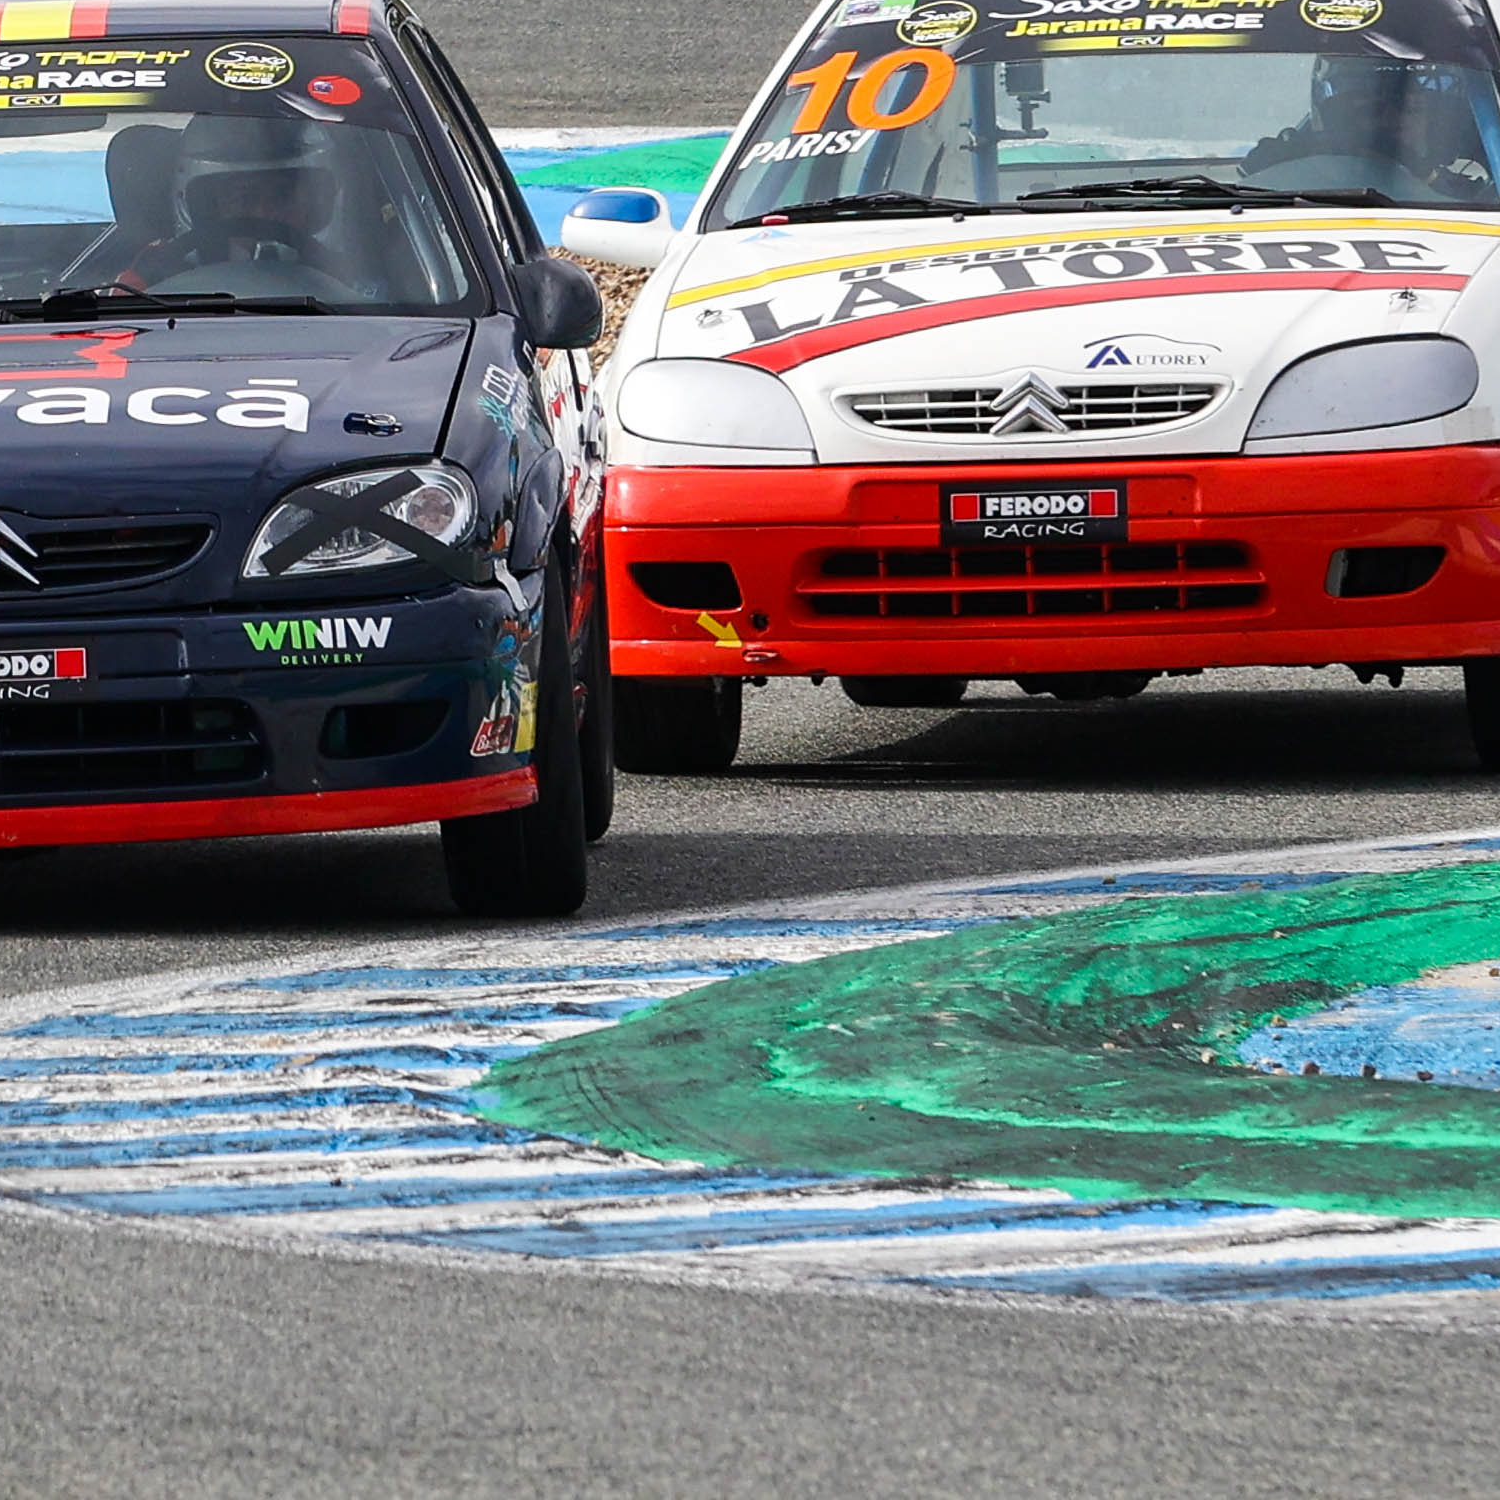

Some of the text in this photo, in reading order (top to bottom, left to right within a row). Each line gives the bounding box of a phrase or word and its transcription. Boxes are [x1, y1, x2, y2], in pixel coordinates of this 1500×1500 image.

[1119, 35, 1163, 48] CRV
[36, 49, 190, 66] TROPHY
[213, 50, 287, 66] Saxo
[224, 76, 273, 85] RACE
[11, 95, 58, 107] CRV
[788, 48, 957, 134] 10
[738, 128, 879, 170] PARISI
[838, 233, 1246, 282] DESGUACES
[736, 239, 1450, 345] LA TORRE
[1085, 345, 1210, 369] AUTOREY
[985, 494, 1086, 518] FERODO
[984, 522, 1085, 539] RACING
[242, 617, 392, 650] WINIW
[281, 653, 363, 665] DELIVERY
